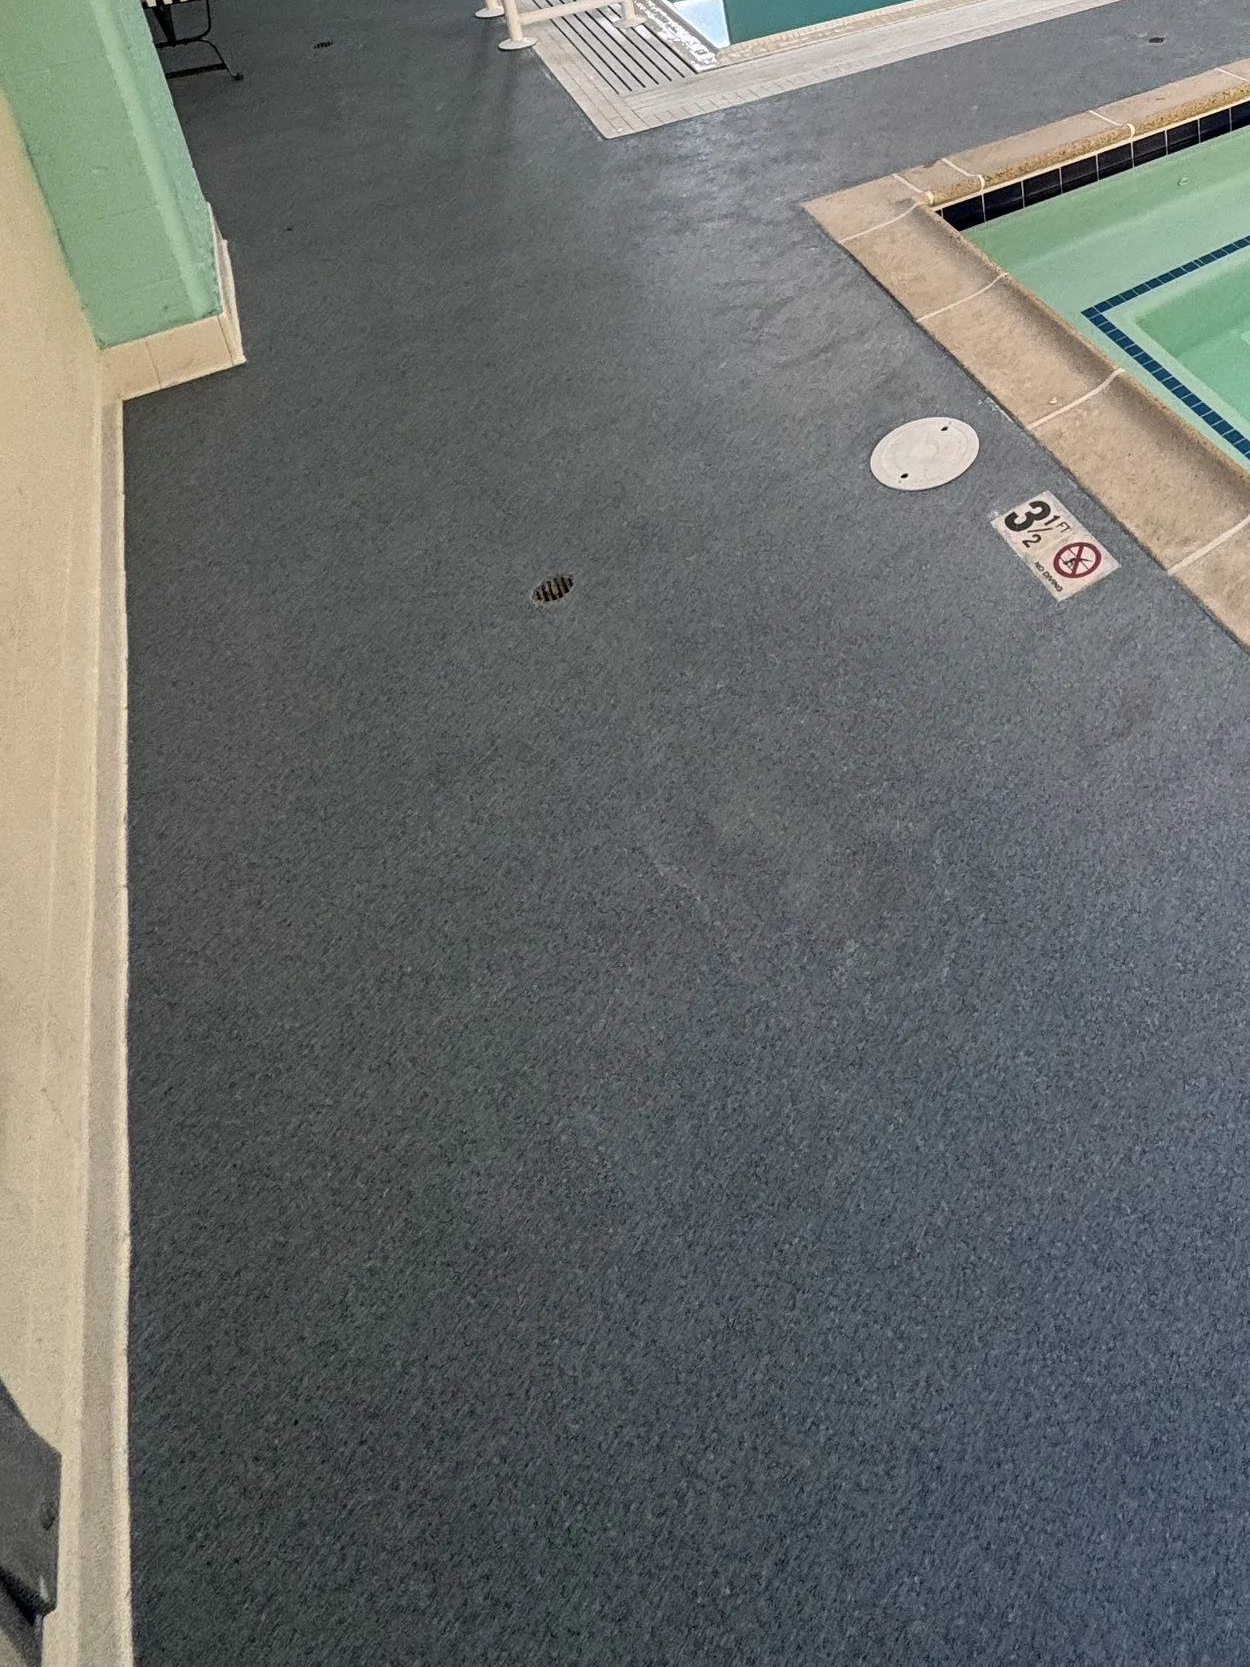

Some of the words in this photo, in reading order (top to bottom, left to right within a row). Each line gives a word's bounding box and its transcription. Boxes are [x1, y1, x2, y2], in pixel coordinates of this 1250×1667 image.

[1056, 521, 1071, 534] FT
[1034, 561, 1045, 572] NO
[1043, 570, 1064, 593] DIVING
